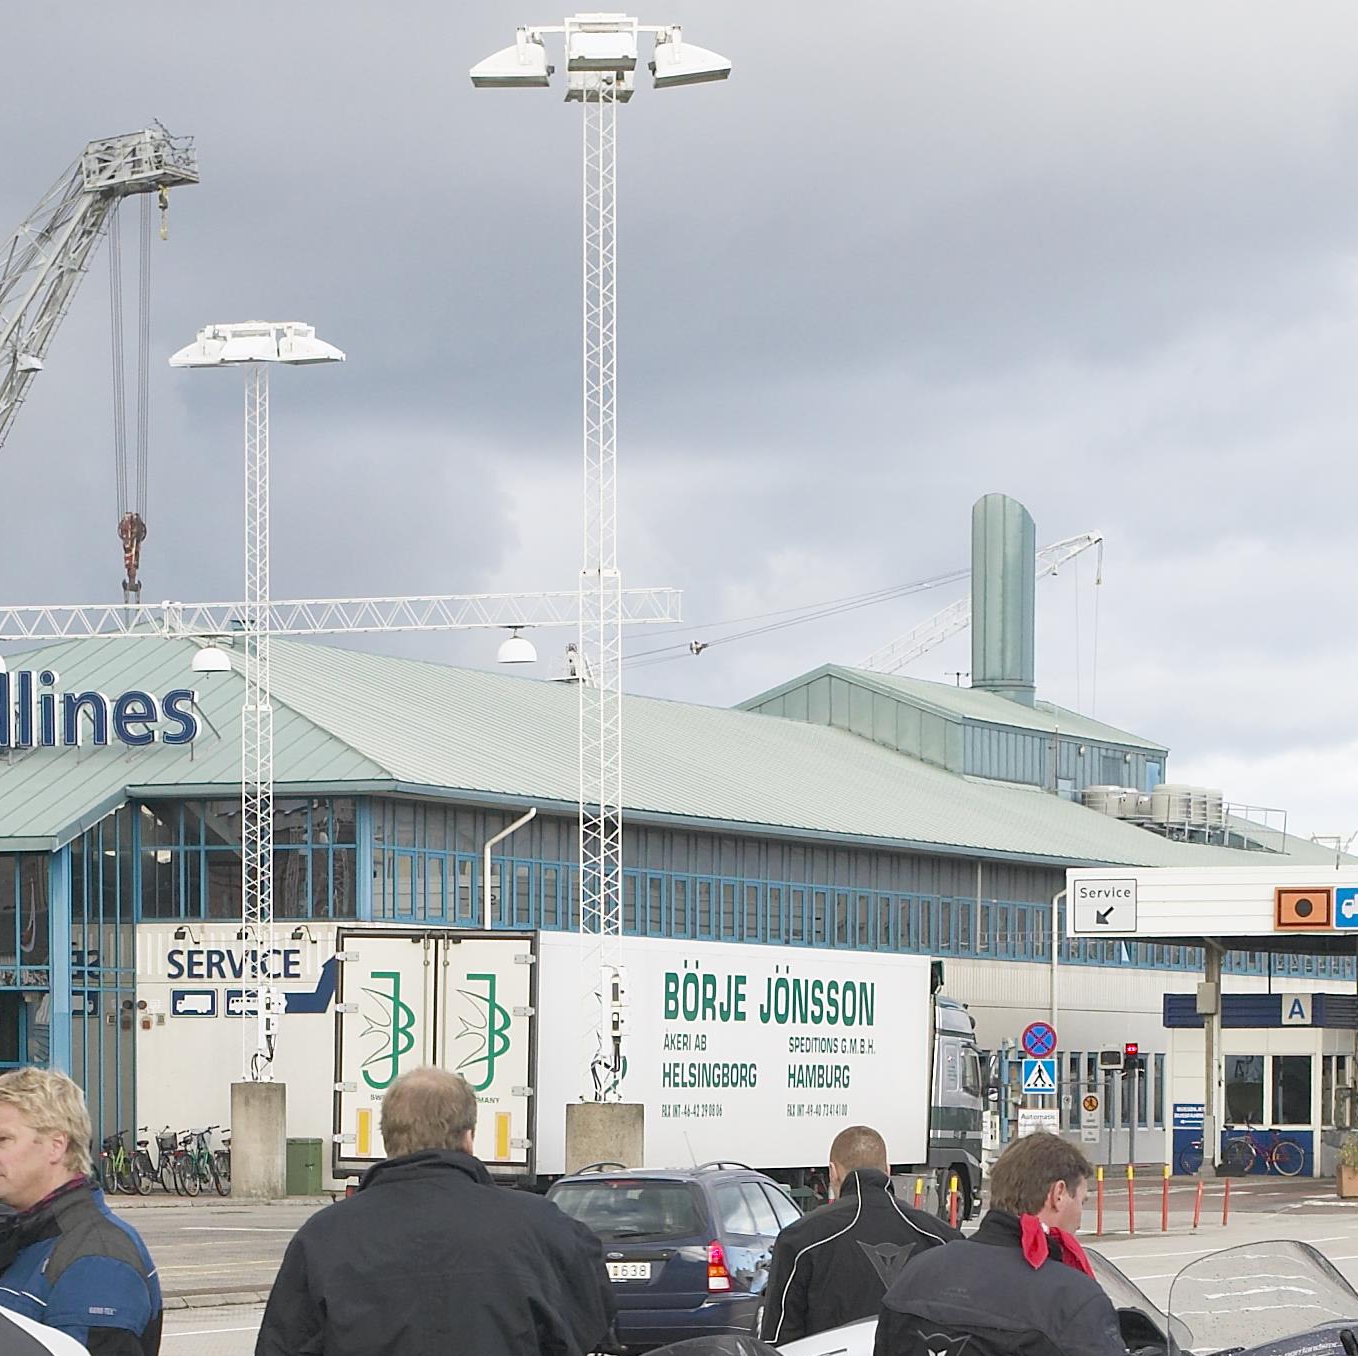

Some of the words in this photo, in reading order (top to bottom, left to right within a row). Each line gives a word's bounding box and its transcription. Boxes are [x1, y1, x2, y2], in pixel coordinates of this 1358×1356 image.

[1079, 886, 1131, 898] Service
[167, 949, 301, 979] SERVICE
[664, 959, 747, 1022] BÖRJE
[759, 965, 875, 1026] JÖNSSON
[1288, 998, 1305, 1019] A
[663, 1028, 691, 1051] ÅKERI
[694, 1034, 707, 1051] AB
[789, 1037, 838, 1053] SPEDITIONS
[663, 1062, 757, 1088] HELSINGBORG
[787, 1065, 850, 1088] HAMBURG
[622, 1265, 646, 1276] 638
